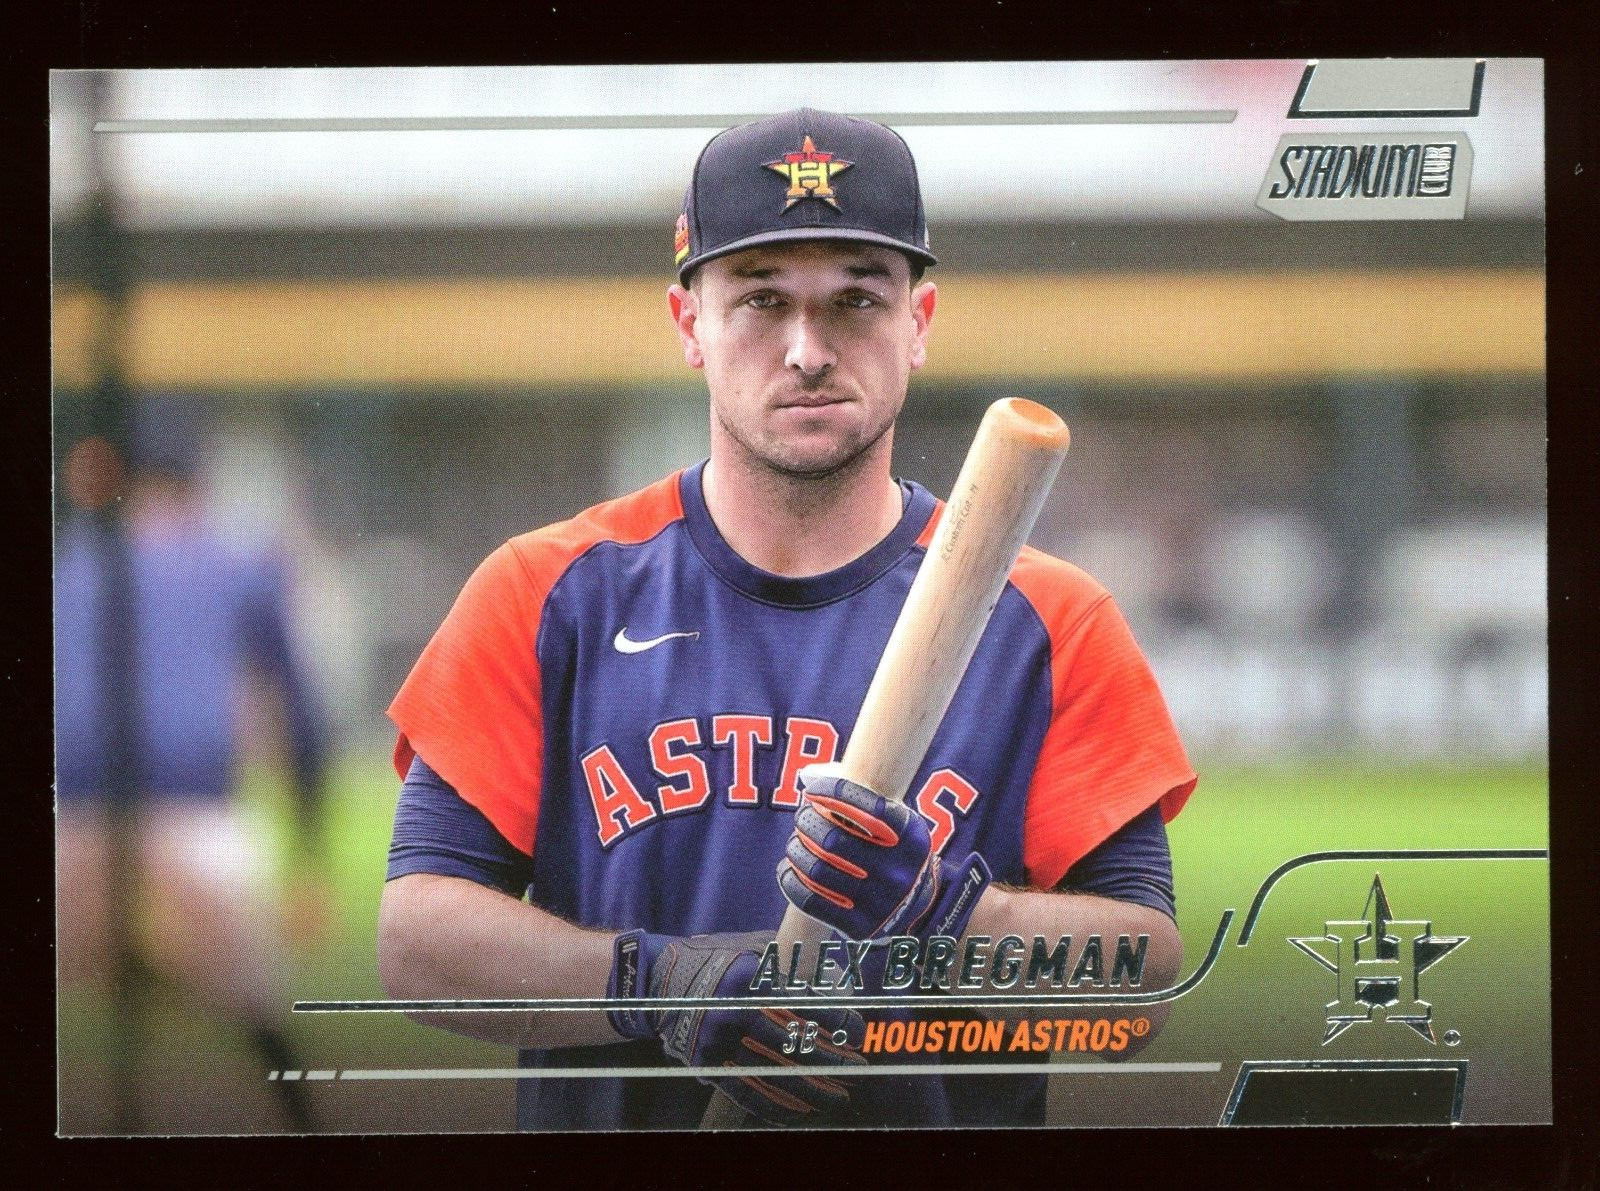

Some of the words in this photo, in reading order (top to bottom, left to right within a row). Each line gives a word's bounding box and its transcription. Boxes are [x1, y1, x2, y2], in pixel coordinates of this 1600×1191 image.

[1268, 144, 1422, 199] STADIUM
[1420, 146, 1452, 194] CLUB
[580, 713, 980, 853] ASTRS
[750, 941, 872, 990] ALEX
[882, 934, 1150, 990] BREGMAN
[783, 1021, 819, 1053] 3B
[862, 1020, 1005, 1053] HOUSTON
